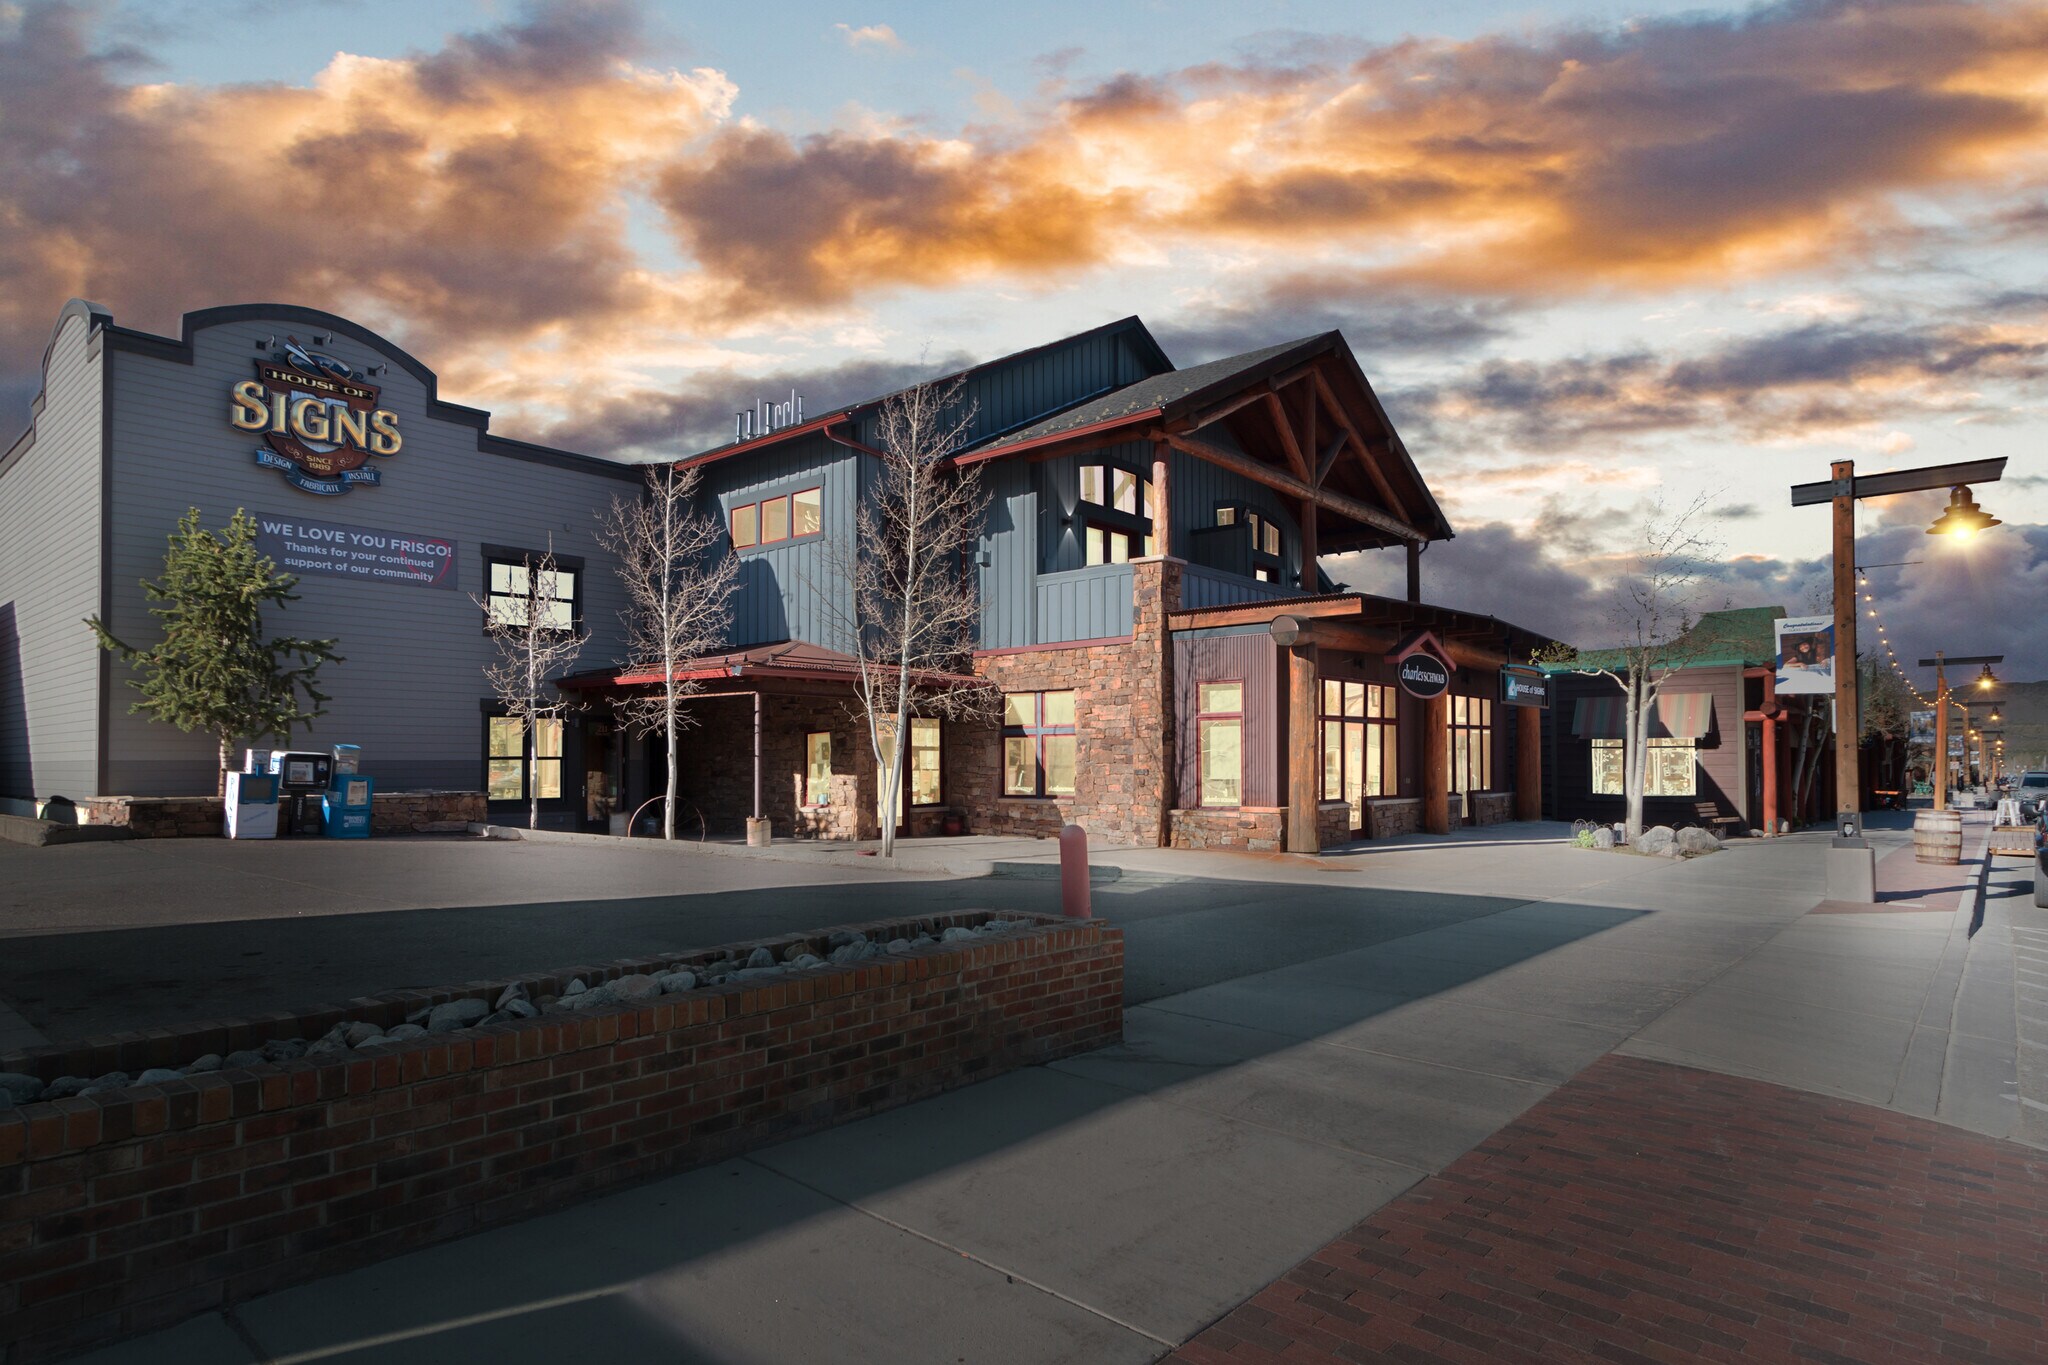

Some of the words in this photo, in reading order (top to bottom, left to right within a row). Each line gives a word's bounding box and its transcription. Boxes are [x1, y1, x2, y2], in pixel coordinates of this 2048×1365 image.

[272, 370, 338, 392] HOUSE
[343, 387, 369, 398] OF
[232, 380, 402, 455] SIGNS
[263, 453, 292, 470] DESIGN
[306, 454, 333, 466] SINCE
[309, 462, 331, 471] 1989
[348, 472, 375, 481] INSTALL
[300, 478, 340, 493] FABRICATE
[262, 520, 293, 537] WE
[298, 526, 345, 544] LOVE
[350, 533, 386, 549] YOU
[391, 539, 452, 558] FRISCO!
[284, 541, 328, 555] Thanks
[330, 547, 348, 558] for
[350, 551, 377, 561] your
[379, 555, 434, 569] continued
[284, 557, 332, 570] support
[335, 562, 348, 572] of
[350, 565, 370, 574] our
[373, 568, 434, 583] community
[1516, 683, 1530, 694] HOUSE
[1534, 686, 1545, 696] SIGNS
